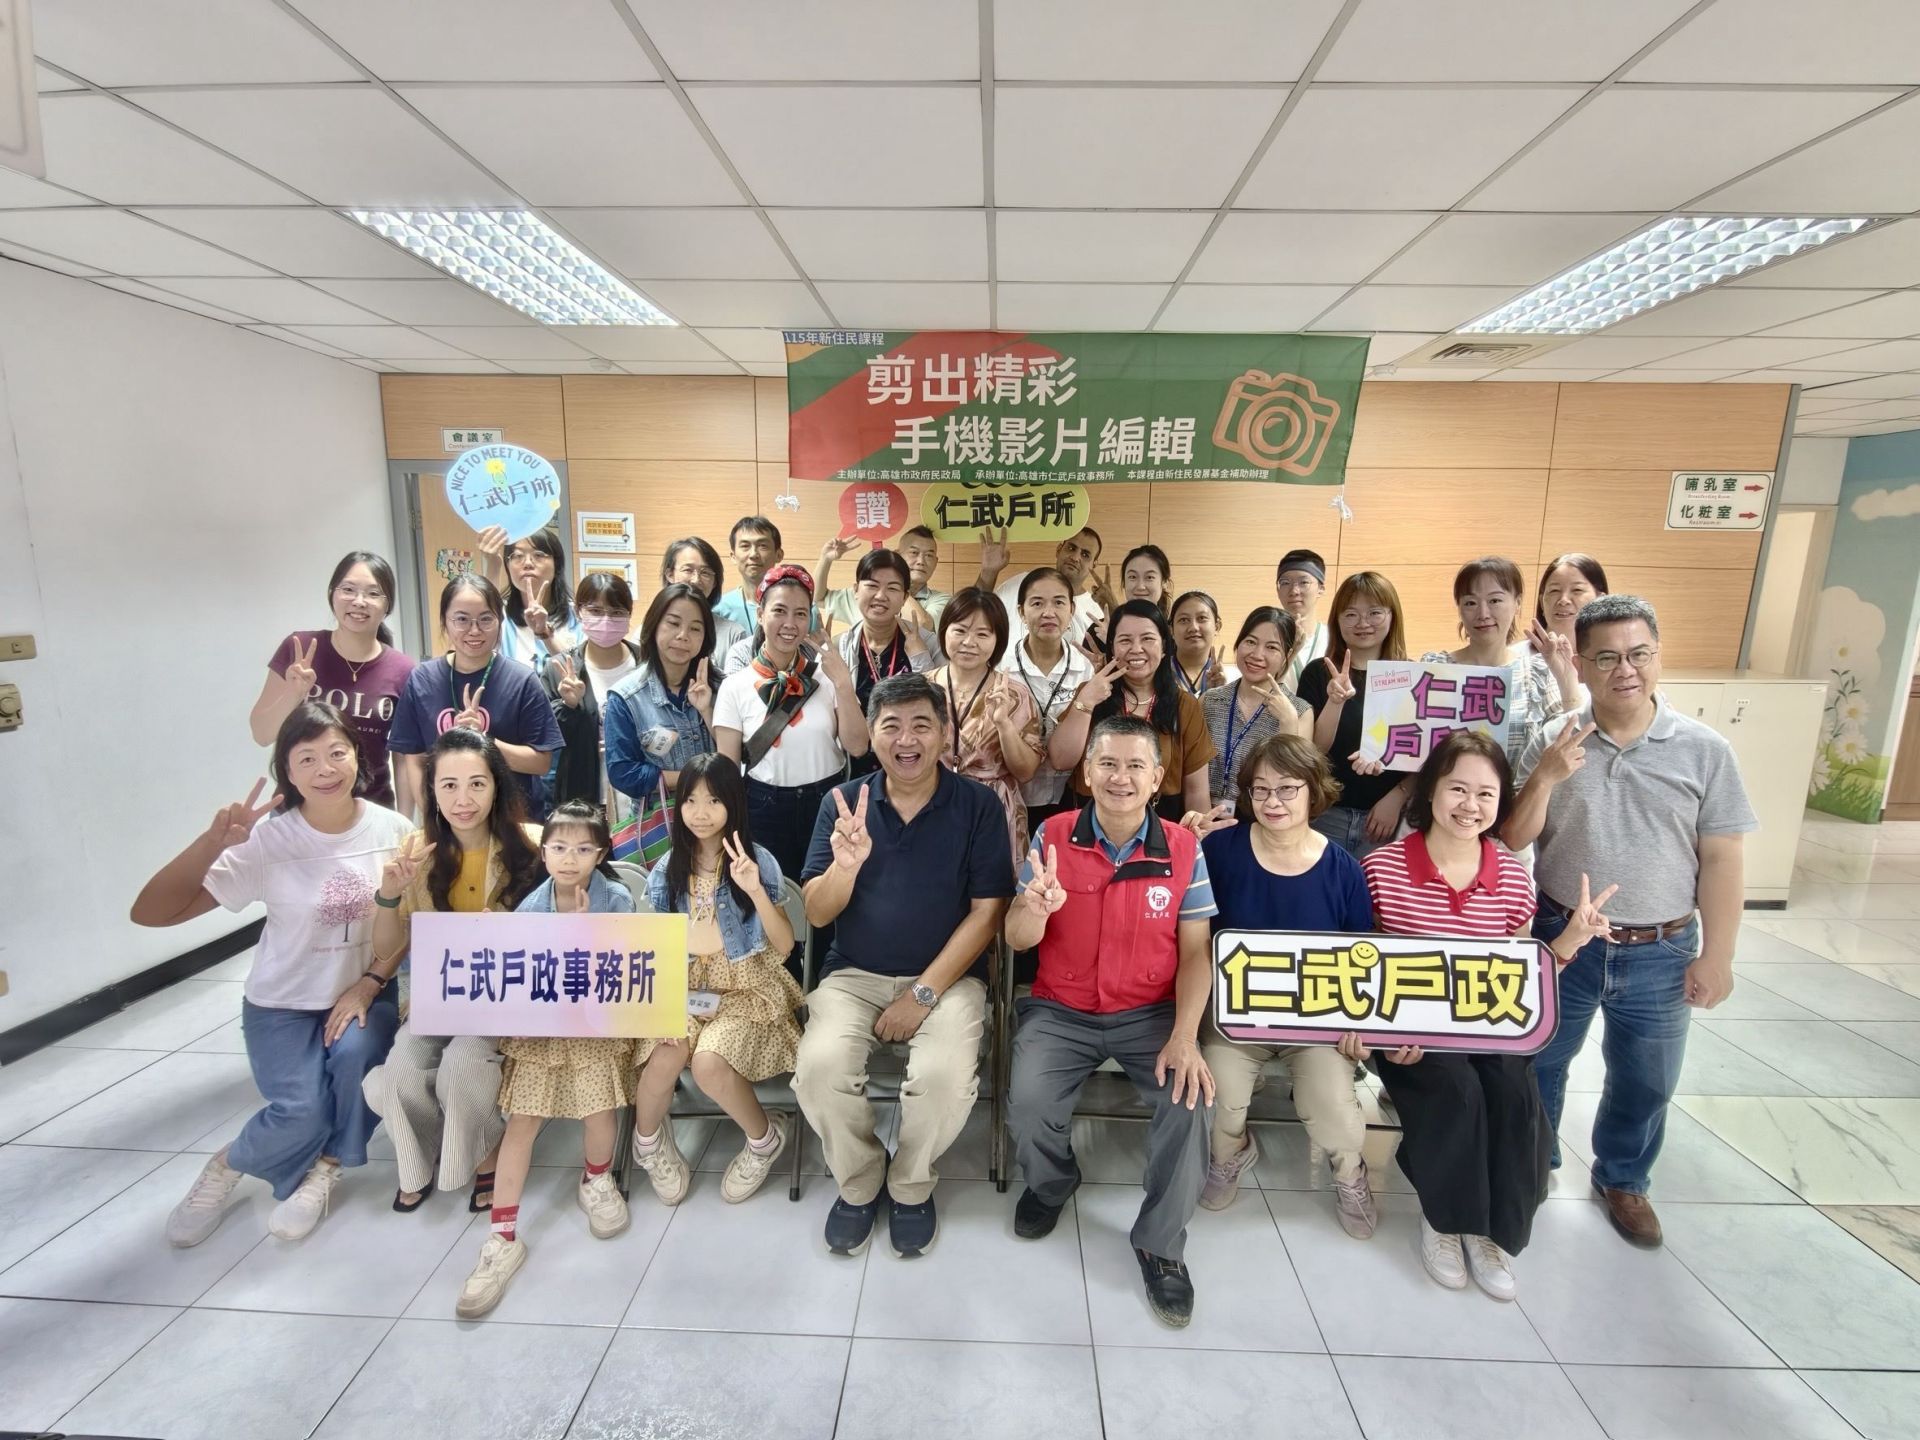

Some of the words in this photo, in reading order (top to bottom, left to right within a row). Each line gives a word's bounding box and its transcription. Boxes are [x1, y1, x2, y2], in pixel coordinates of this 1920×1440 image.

[785, 332, 884, 345] 115年新住民課程
[867, 353, 1077, 405] 剪出精彩
[891, 416, 1195, 468] 手機影片編輯
[451, 466, 470, 491] NICE
[464, 454, 481, 468] TO
[481, 447, 513, 460] MEET
[517, 451, 541, 469] YOU
[837, 470, 961, 480] 主辦單位:高雄市政府民政局
[975, 470, 1115, 481] 承辦單位:高雄市仁武戶政事務所
[1127, 469, 1269, 480] 本課程由新住民發展基金補助辦理
[1685, 477, 1738, 491] 哺乳室
[460, 476, 555, 515] 仁武戶所
[855, 491, 891, 529] 讚
[934, 491, 1076, 530] 仁武戶所
[303, 684, 394, 721] POLO
[1411, 671, 1506, 725] 仁武
[440, 948, 656, 1003] 仁武戶政事務所
[1219, 941, 1533, 1028] 仁武戶政
